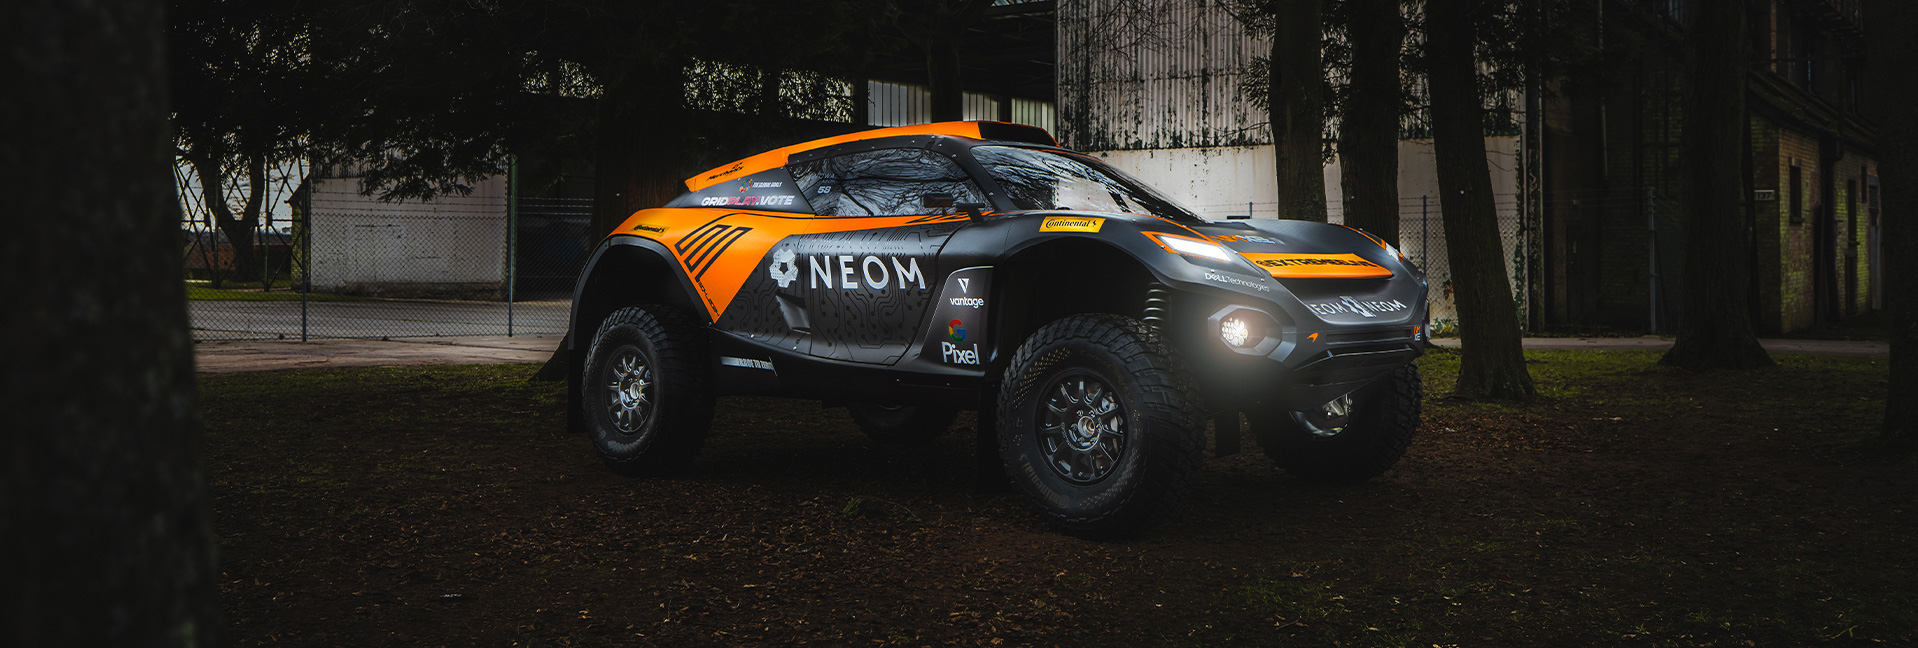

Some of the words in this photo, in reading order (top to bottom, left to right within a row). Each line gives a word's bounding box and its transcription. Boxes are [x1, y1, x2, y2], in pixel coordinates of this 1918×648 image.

[817, 186, 832, 194] 58
[701, 195, 795, 206] GRIDPLAY.VOTE
[1045, 219, 1090, 229] Continental
[809, 254, 926, 290] NEOM
[949, 296, 984, 309] vantage
[941, 341, 981, 365] Pixel
